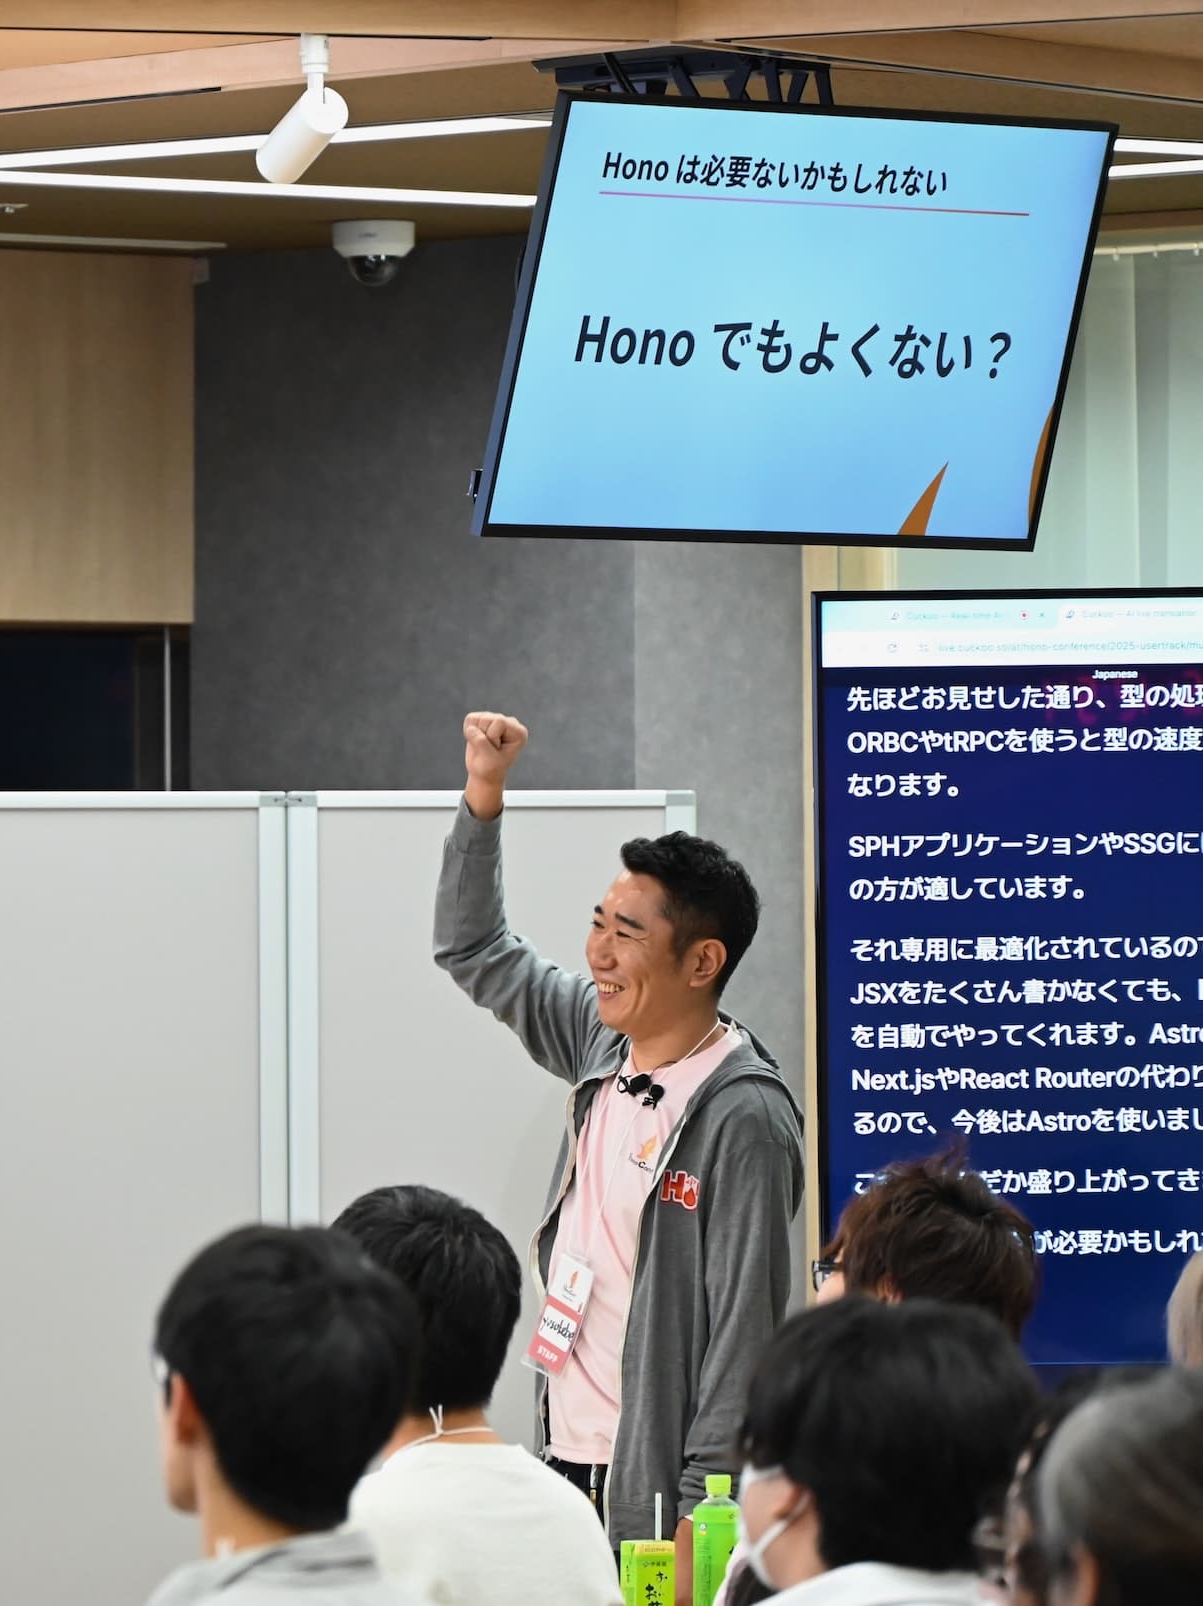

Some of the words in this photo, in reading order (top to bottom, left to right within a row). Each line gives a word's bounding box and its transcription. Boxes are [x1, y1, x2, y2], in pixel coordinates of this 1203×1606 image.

[602, 151, 669, 182] Hono
[676, 154, 948, 197] は必要ないかもしれない
[574, 315, 695, 367] Hono
[1092, 670, 1138, 681] Japanese
[847, 772, 959, 797] なります。
[848, 831, 1203, 858] SPHアプリケーションやSSGに
[849, 875, 1085, 902] の方が適しています。
[850, 979, 1203, 1005] JSXをたくさん書かなくても、
[852, 1066, 1029, 1095] Next.jsやReact
[1034, 1229, 1203, 1255] が必要かもしれ
[537, 1344, 559, 1363] STAFF
